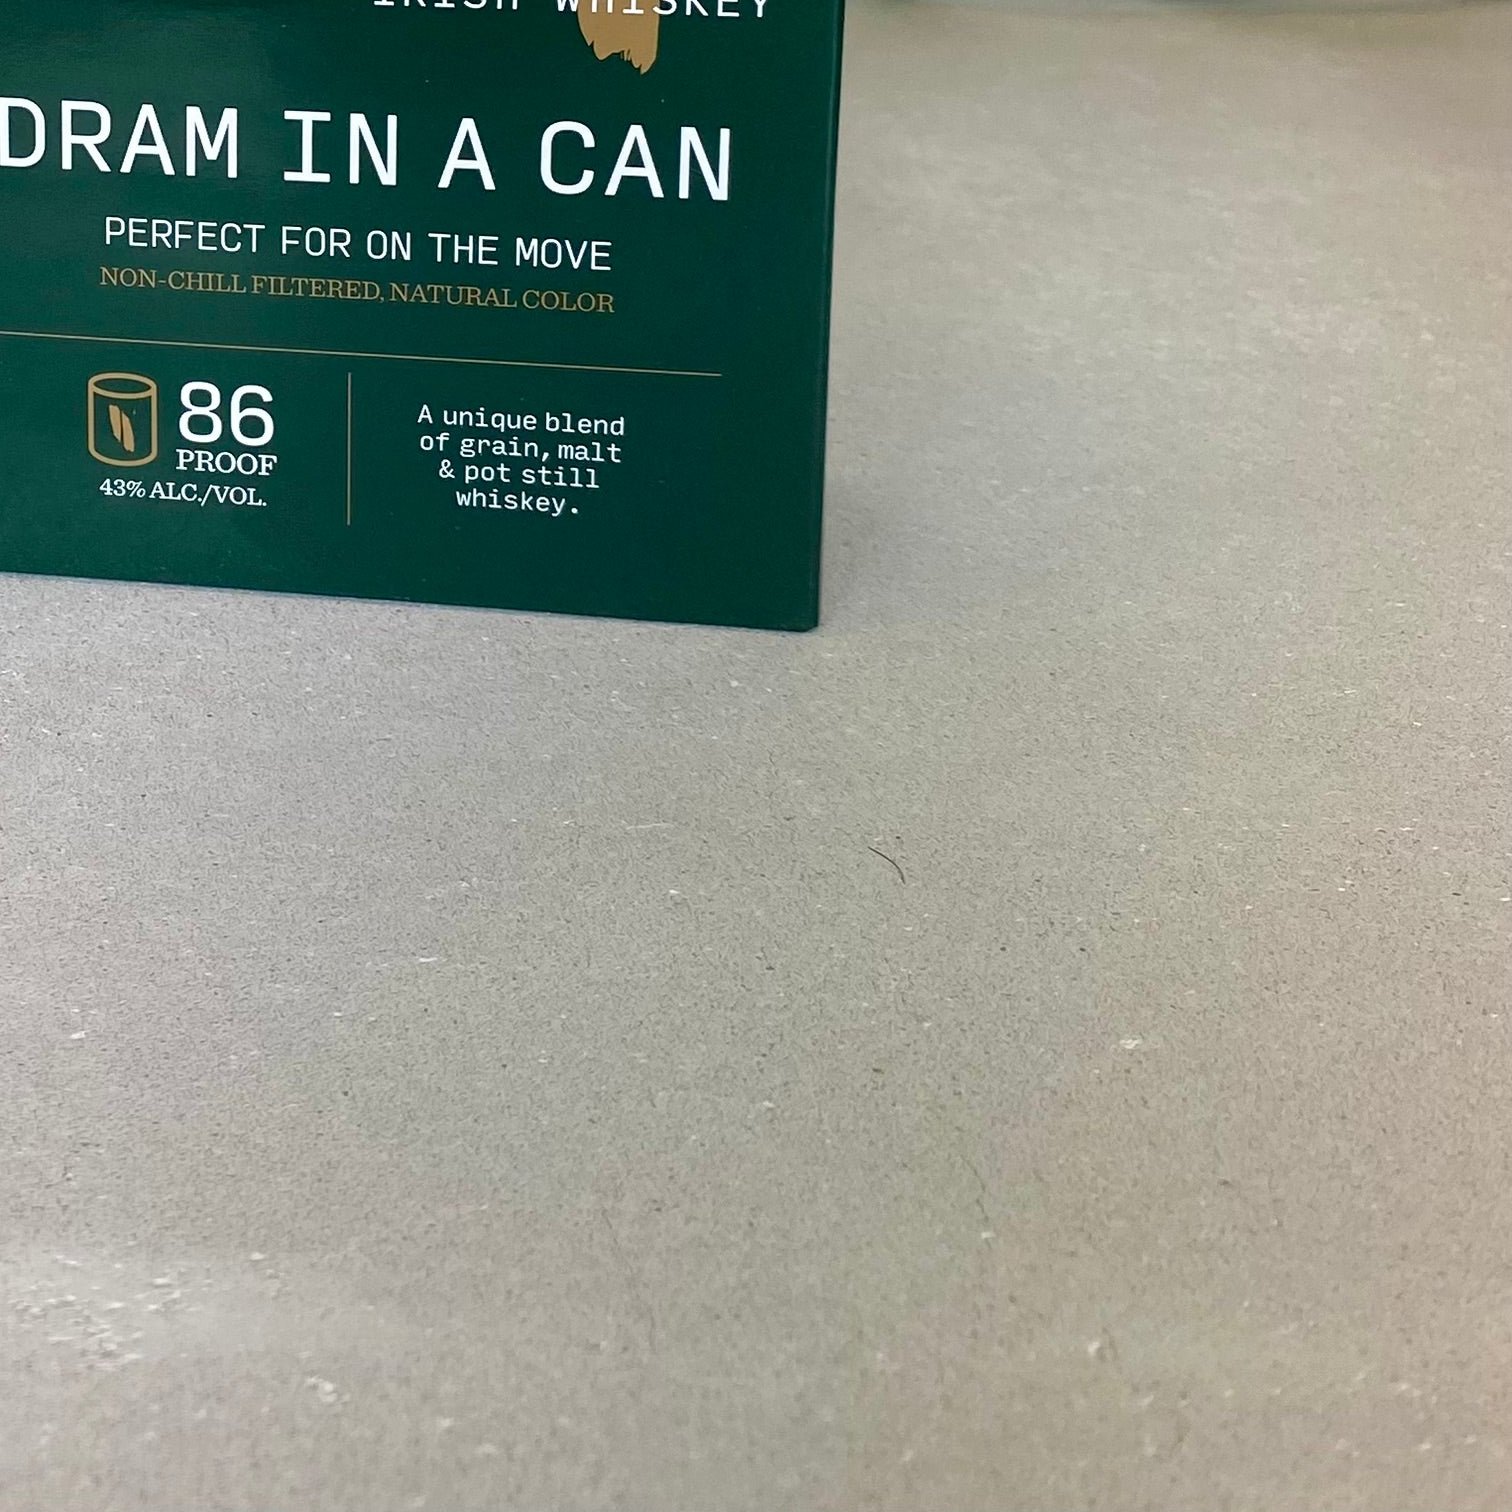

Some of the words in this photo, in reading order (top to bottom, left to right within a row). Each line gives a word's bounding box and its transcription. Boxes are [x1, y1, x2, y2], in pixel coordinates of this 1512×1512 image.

[283, 110, 398, 186] IN
[437, 117, 496, 191] A
[540, 120, 731, 201] CAN
[105, 216, 266, 253] PERFECT
[281, 225, 351, 258] FOR
[366, 230, 411, 261] ON
[427, 232, 499, 266] THE
[515, 237, 612, 271] MOVE
[99, 266, 247, 293] NON-CHILL
[251, 274, 385, 302] FILTERED,
[389, 282, 518, 308] NATURAL
[522, 289, 615, 313] COLOR
[177, 381, 275, 447] 86
[417, 404, 433, 424] A
[442, 406, 538, 433] unique
[545, 411, 625, 436] blend
[175, 448, 278, 476] PROOF
[420, 432, 450, 452] of
[459, 436, 550, 462] grain,
[558, 441, 621, 463] malt
[438, 458, 456, 479] &
[464, 463, 512, 484] pot
[521, 465, 600, 489] still
[455, 487, 580, 517] whiskey.
